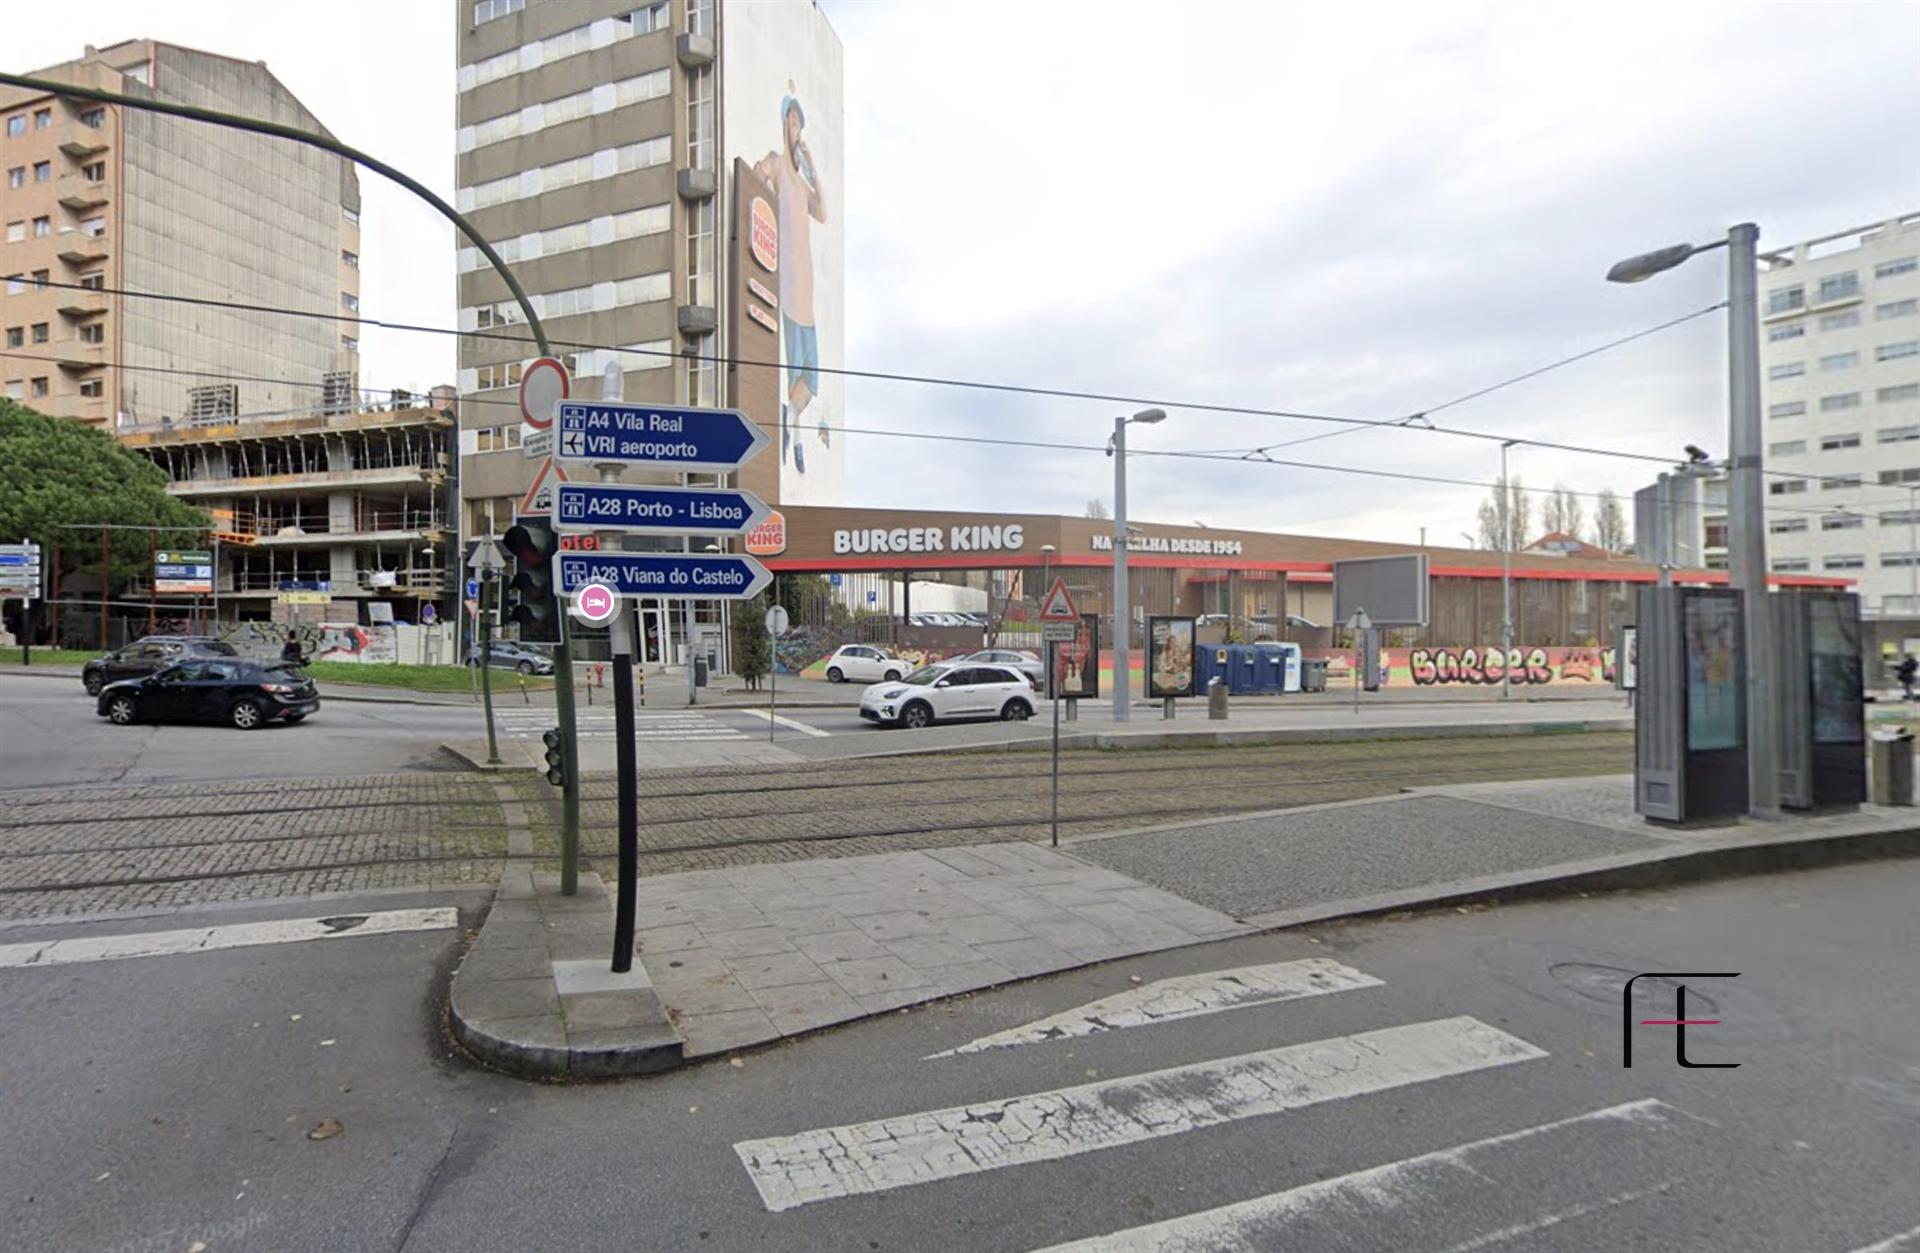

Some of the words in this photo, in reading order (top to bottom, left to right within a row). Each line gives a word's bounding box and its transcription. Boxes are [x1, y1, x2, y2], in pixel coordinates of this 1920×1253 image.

[587, 411, 610, 429] A4
[614, 412, 645, 431] Vila
[649, 414, 683, 433] Real
[587, 436, 616, 454] VRI
[620, 441, 698, 460] aeroporto
[587, 498, 622, 516] A28
[627, 499, 673, 518] Porto
[690, 502, 743, 520] Lisboa
[747, 533, 783, 546] KING
[834, 527, 945, 554] BURGER
[951, 524, 1024, 551] KING
[1092, 535, 1113, 551] NA
[1170, 538, 1211, 554] DESDE
[590, 566, 619, 584] A28
[622, 567, 665, 585] Viana
[669, 567, 689, 585] do
[692, 567, 745, 586] Castelo
